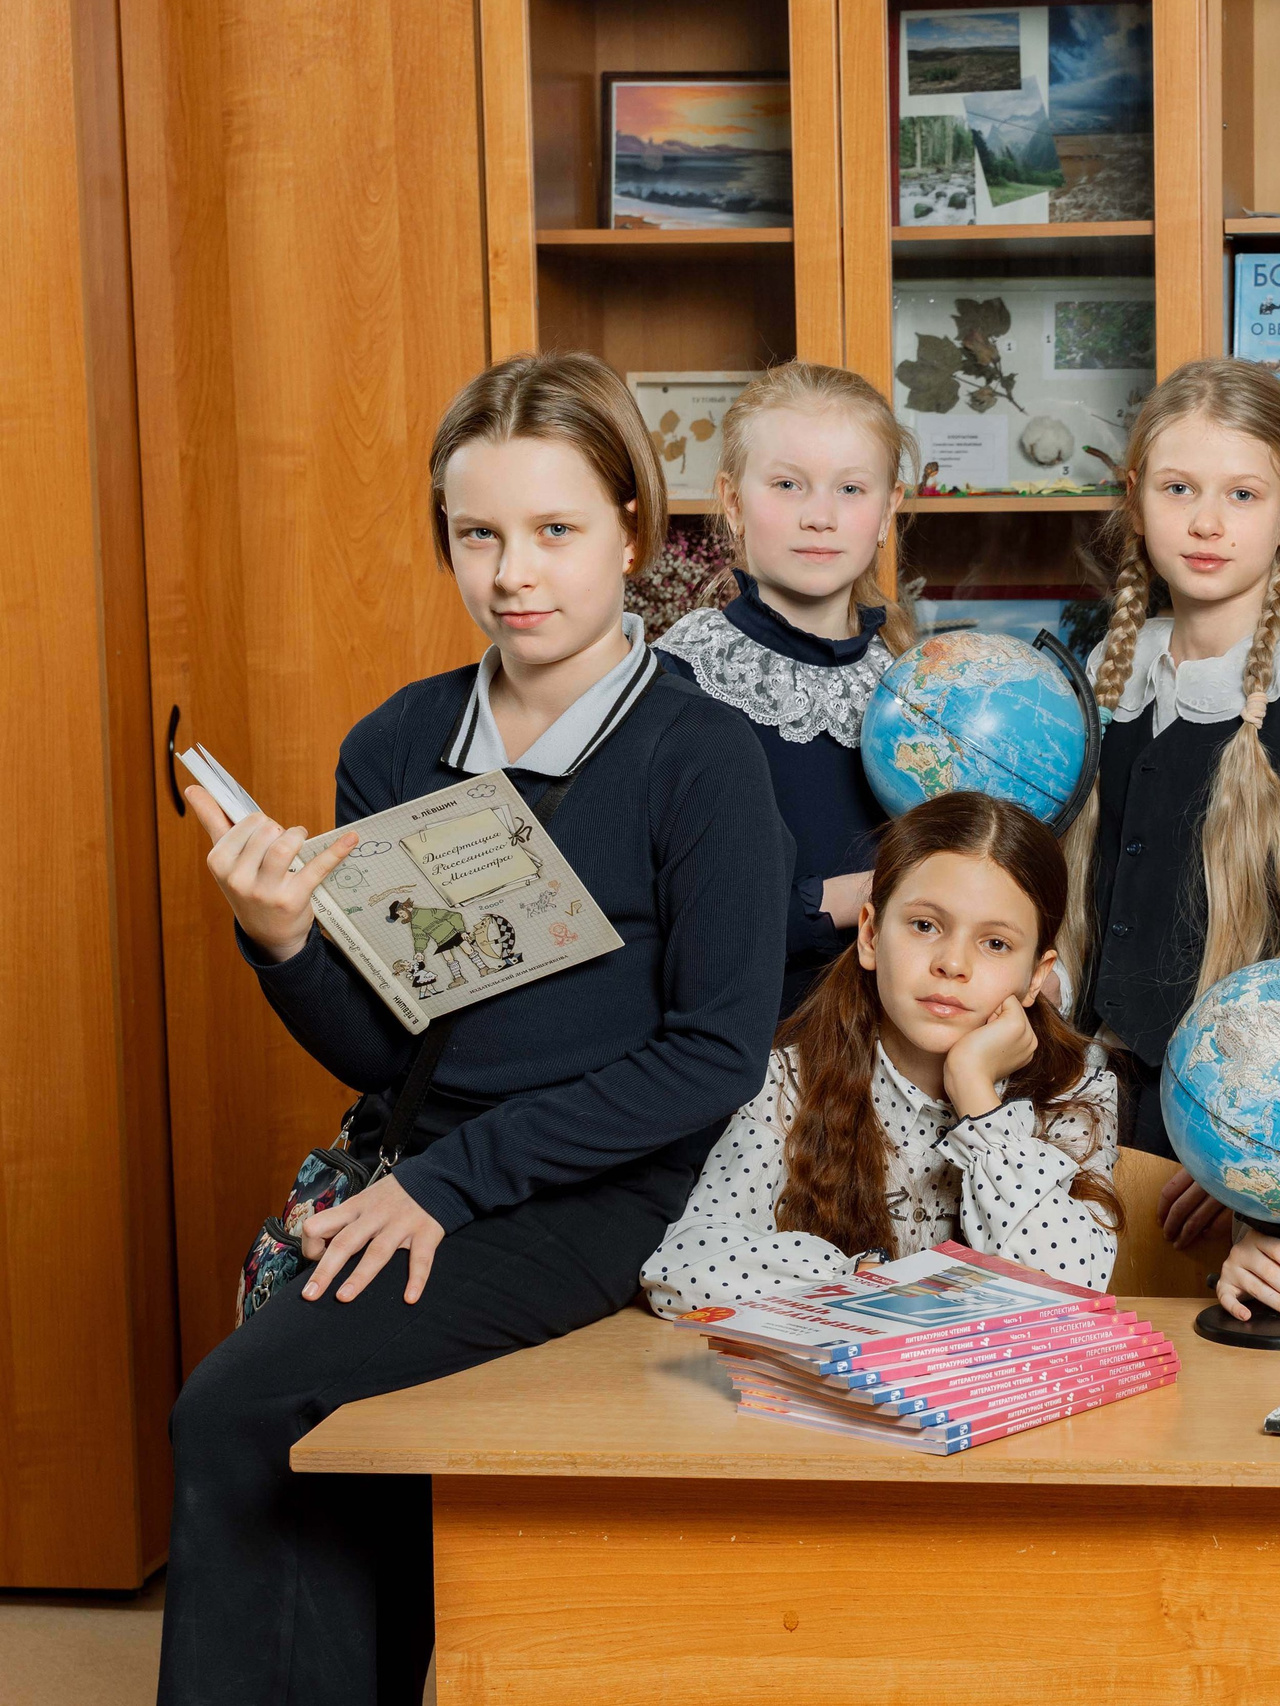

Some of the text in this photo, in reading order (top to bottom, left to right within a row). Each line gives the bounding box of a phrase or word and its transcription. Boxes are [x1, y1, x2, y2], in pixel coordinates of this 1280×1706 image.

[1251, 323, 1265, 336] О
[1063, 466, 1069, 475] 3
[421, 800, 458, 817] ЛЁВШИН
[422, 832, 502, 865] Диссертация
[432, 842, 508, 876] Рассеянного
[442, 855, 514, 887] Магистра
[393, 995, 416, 1021] ЛЁВШИН
[761, 1296, 831, 1315] ЧТЕНИЕ
[801, 1284, 857, 1300] 4
[738, 1300, 888, 1336] ЛИТЕРАТУРНОЕ
[905, 1330, 949, 1344] ЛИТЕРАТУРНОЕ
[949, 1325, 971, 1335] ЧТЕНИЕ
[1040, 1305, 1080, 1317] ПЕРСПЕКТИВА
[900, 1345, 949, 1359] ЛИТЕРАТУРНОЕ
[949, 1341, 974, 1351] ЧТЕНИЕ
[1050, 1320, 1096, 1334] ПЕРСПЕКТИВА
[927, 1358, 973, 1372] ЛИТЕРАТУРНОЕ
[973, 1353, 997, 1362] ЧТЕНИЕ
[1070, 1330, 1114, 1344] ПЕРСПЕКТИВА
[949, 1373, 993, 1387] ЛИТЕРАТУРНОЕ
[993, 1367, 1017, 1377] ЧТЕНИЕ
[1086, 1343, 1127, 1357] ПЕРСПЕКТИВА
[970, 1382, 1012, 1397] ЛИТЕРАТУРНОЕ
[1012, 1376, 1034, 1386] ЧТЕНИЕ
[1099, 1351, 1139, 1366] ПЕРСПЕКТИВА
[988, 1393, 1027, 1408] ЛИТЕРАТУРНОЕ
[1027, 1387, 1048, 1397] ЧТЕНИЕ
[1109, 1361, 1146, 1376] ПЕРСПЕКТИВА
[1007, 1404, 1044, 1419] ЛИТЕРАТУРНОЕ
[1044, 1397, 1062, 1408] ЧТЕНИЕ
[1118, 1370, 1152, 1385] ПЕРСПЕКТИВА
[1007, 1419, 1042, 1434] ЛИТЕРАТУРНОЕ
[1042, 1411, 1061, 1422] ЧТЕНИЕ
[1115, 1384, 1148, 1398] ПЕРСПЕКТИВА
